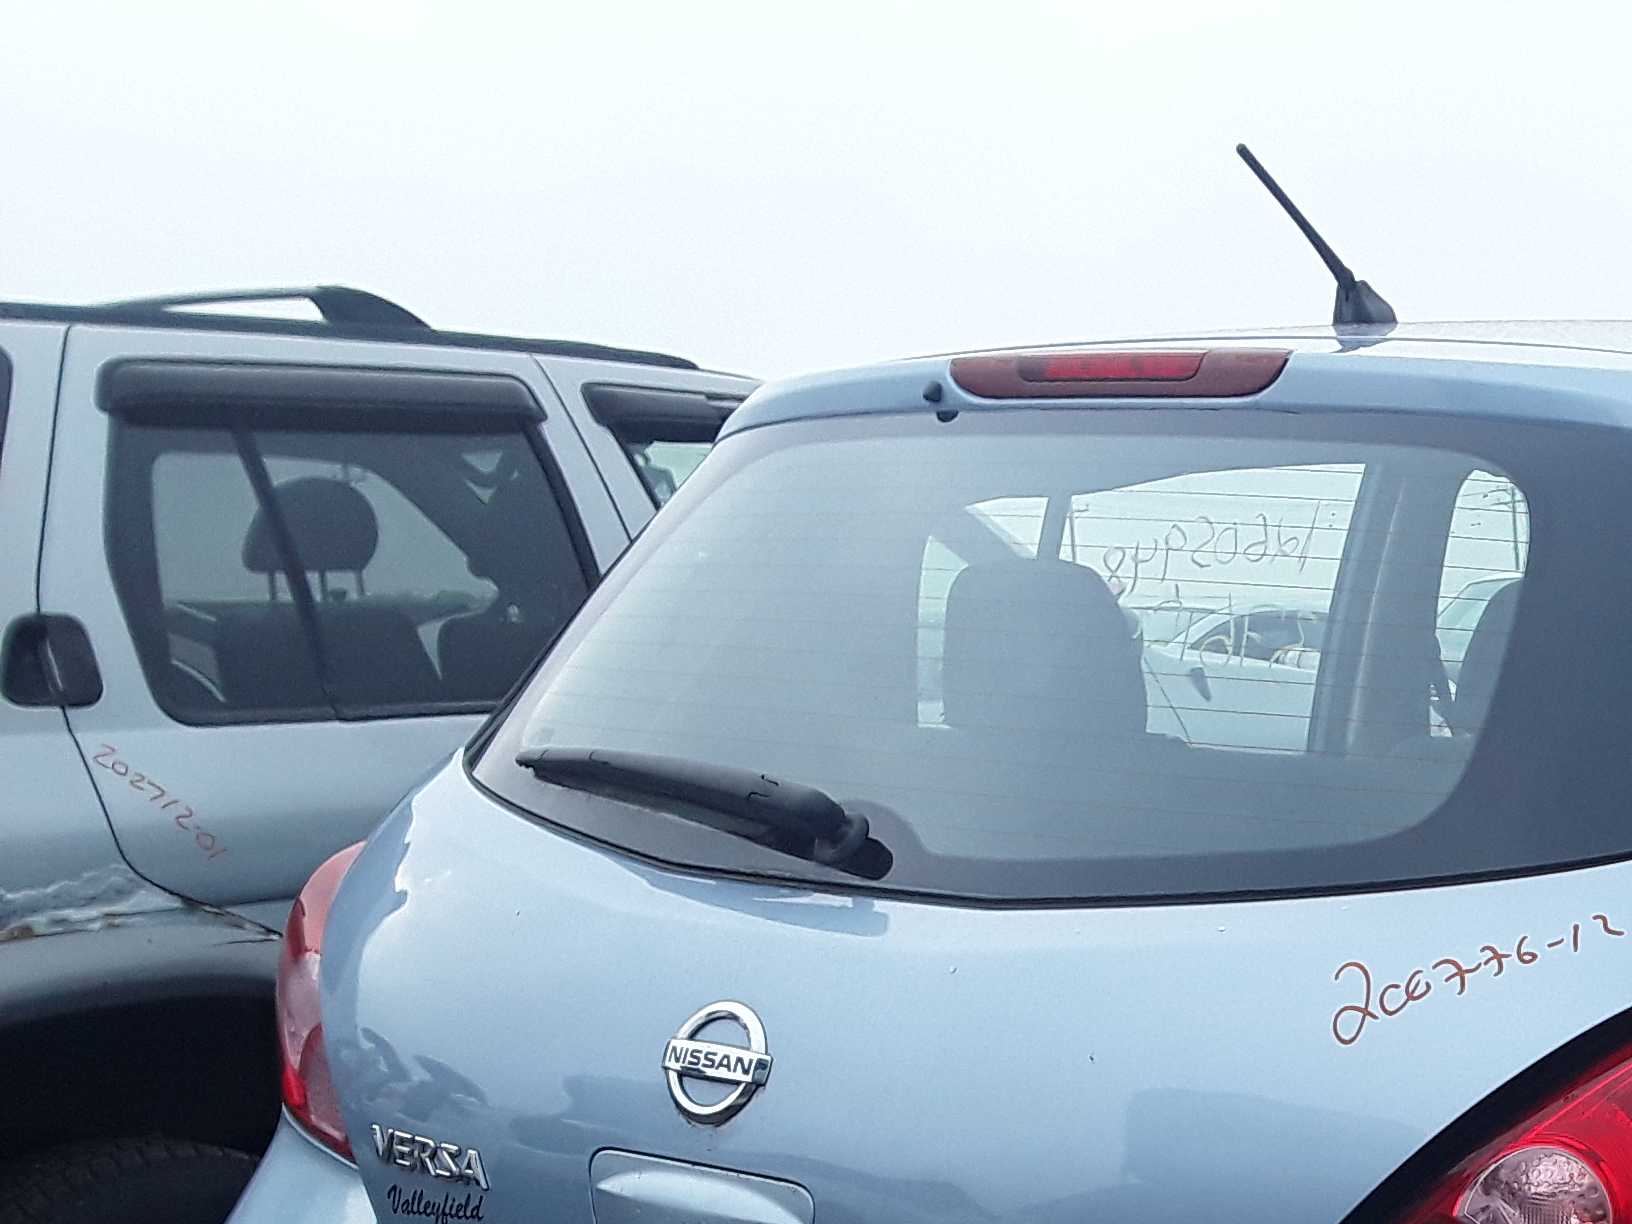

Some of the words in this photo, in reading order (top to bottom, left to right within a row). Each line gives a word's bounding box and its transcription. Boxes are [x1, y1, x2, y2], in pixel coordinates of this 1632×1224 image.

[1331, 912, 1626, 1046] 200776-12
[667, 1045, 755, 1077] NISSAN
[371, 1123, 490, 1191] VERSA
